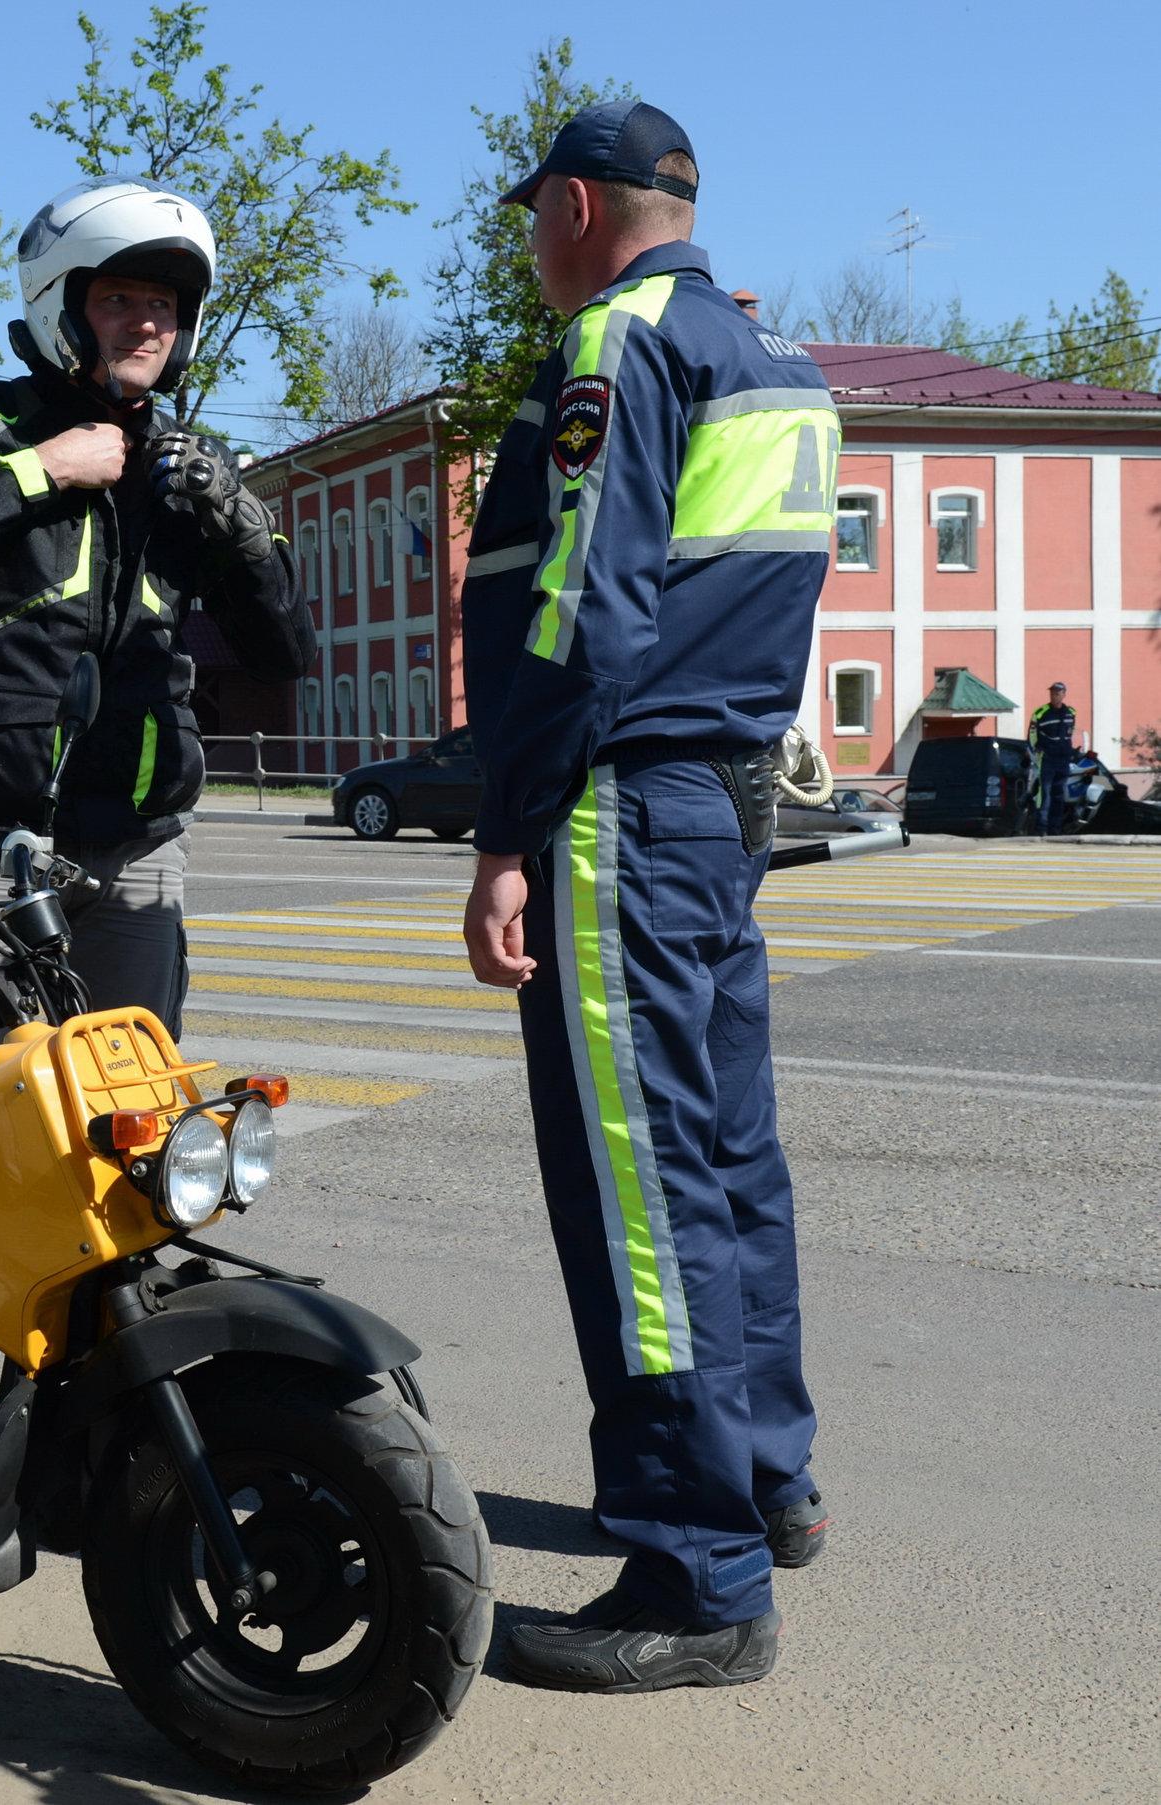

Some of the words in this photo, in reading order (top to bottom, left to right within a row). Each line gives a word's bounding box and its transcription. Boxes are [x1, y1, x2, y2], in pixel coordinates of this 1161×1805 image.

[756, 333, 812, 358] ПОЛ
[562, 380, 605, 398] ПОЛИЦИЯ
[560, 401, 600, 422] РОССИЯ
[566, 462, 584, 478] МВД
[106, 1058, 136, 1071] HONDA
